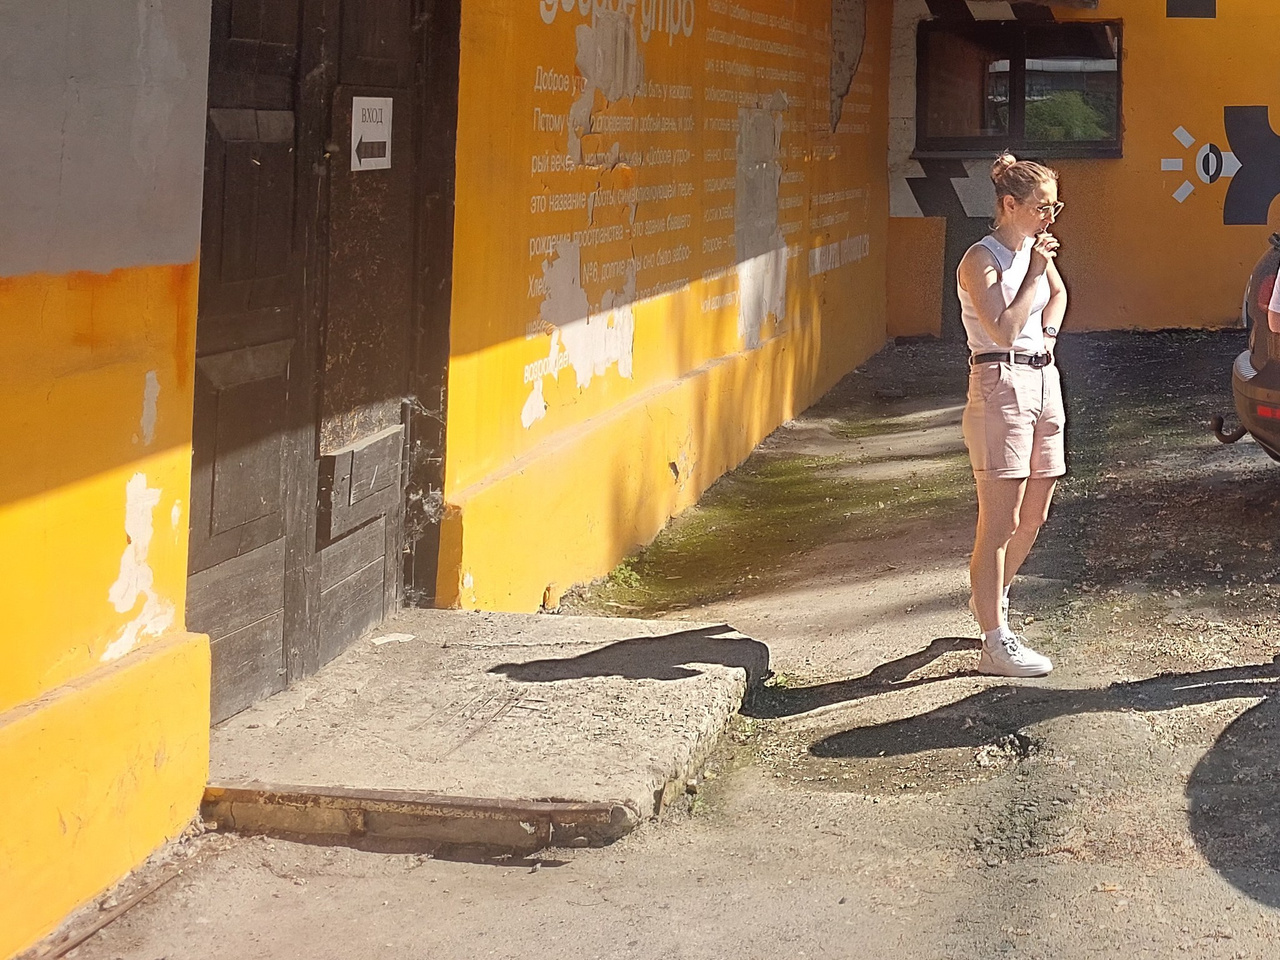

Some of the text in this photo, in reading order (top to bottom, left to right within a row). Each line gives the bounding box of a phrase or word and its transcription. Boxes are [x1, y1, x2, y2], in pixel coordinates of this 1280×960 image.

[534, 66, 570, 95] Доброе
[361, 107, 384, 124] ВХОД
[533, 107, 565, 136] Потому
[531, 149, 549, 178] рый
[530, 195, 547, 214] это
[549, 192, 587, 212] название
